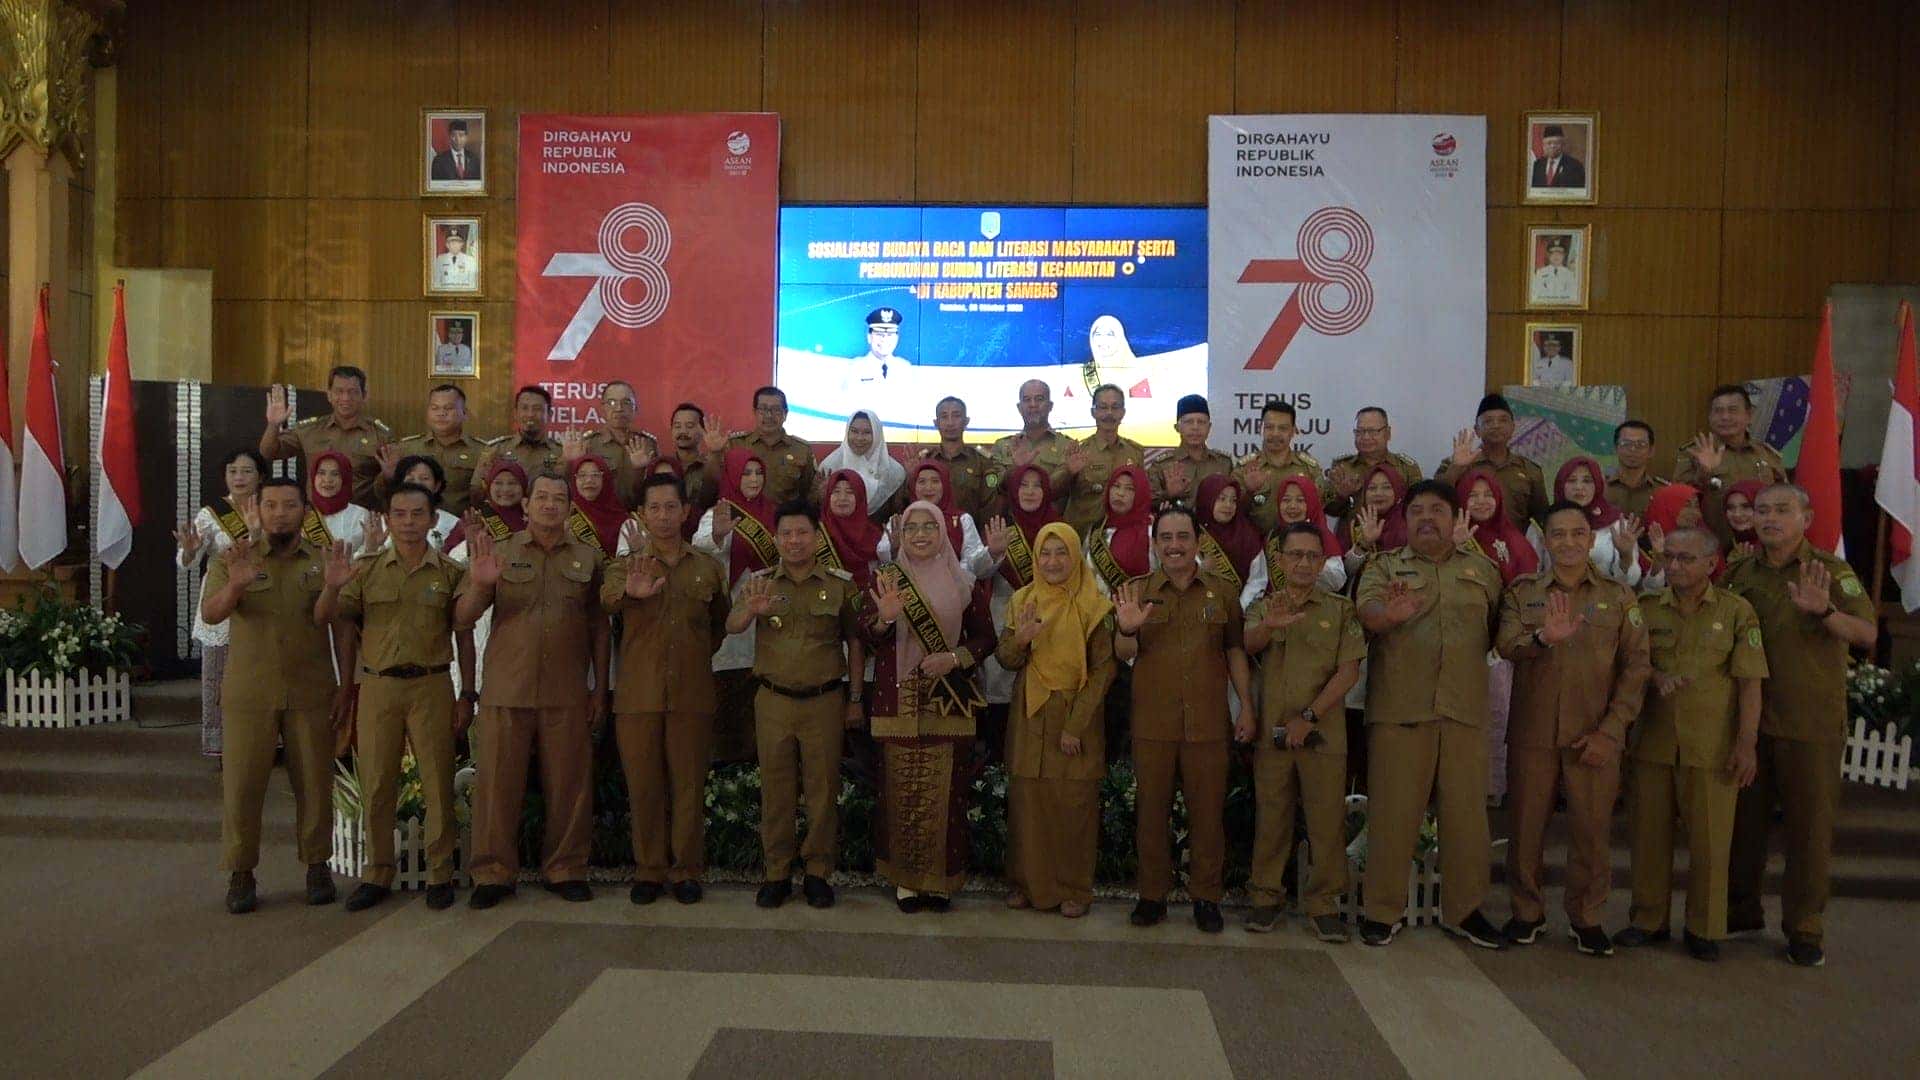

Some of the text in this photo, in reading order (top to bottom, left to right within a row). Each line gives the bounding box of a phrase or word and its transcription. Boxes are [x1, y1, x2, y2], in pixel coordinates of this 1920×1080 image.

[543, 131, 631, 143] DIRGAHAYU
[1236, 133, 1331, 145] DIRGAHAYU
[543, 147, 617, 159] REPUBLIK
[1236, 149, 1315, 161] REPUBLIK
[543, 162, 626, 174] INDONESIA
[1236, 165, 1325, 177] INDONESIA
[808, 239, 1176, 258] SOSIALISASI BUDAYA BACA DAN LITERASI MASYARAKAT SERTA
[942, 262, 983, 278] BUNDA
[986, 261, 1038, 278] LITERASI
[1040, 261, 1116, 277] KECAMATAN
[542, 202, 672, 361] 78
[1237, 206, 1374, 370] 78
[917, 282, 1058, 299] DI KABUPATEN SAMBAS
[1233, 418, 1331, 435] MEJU
